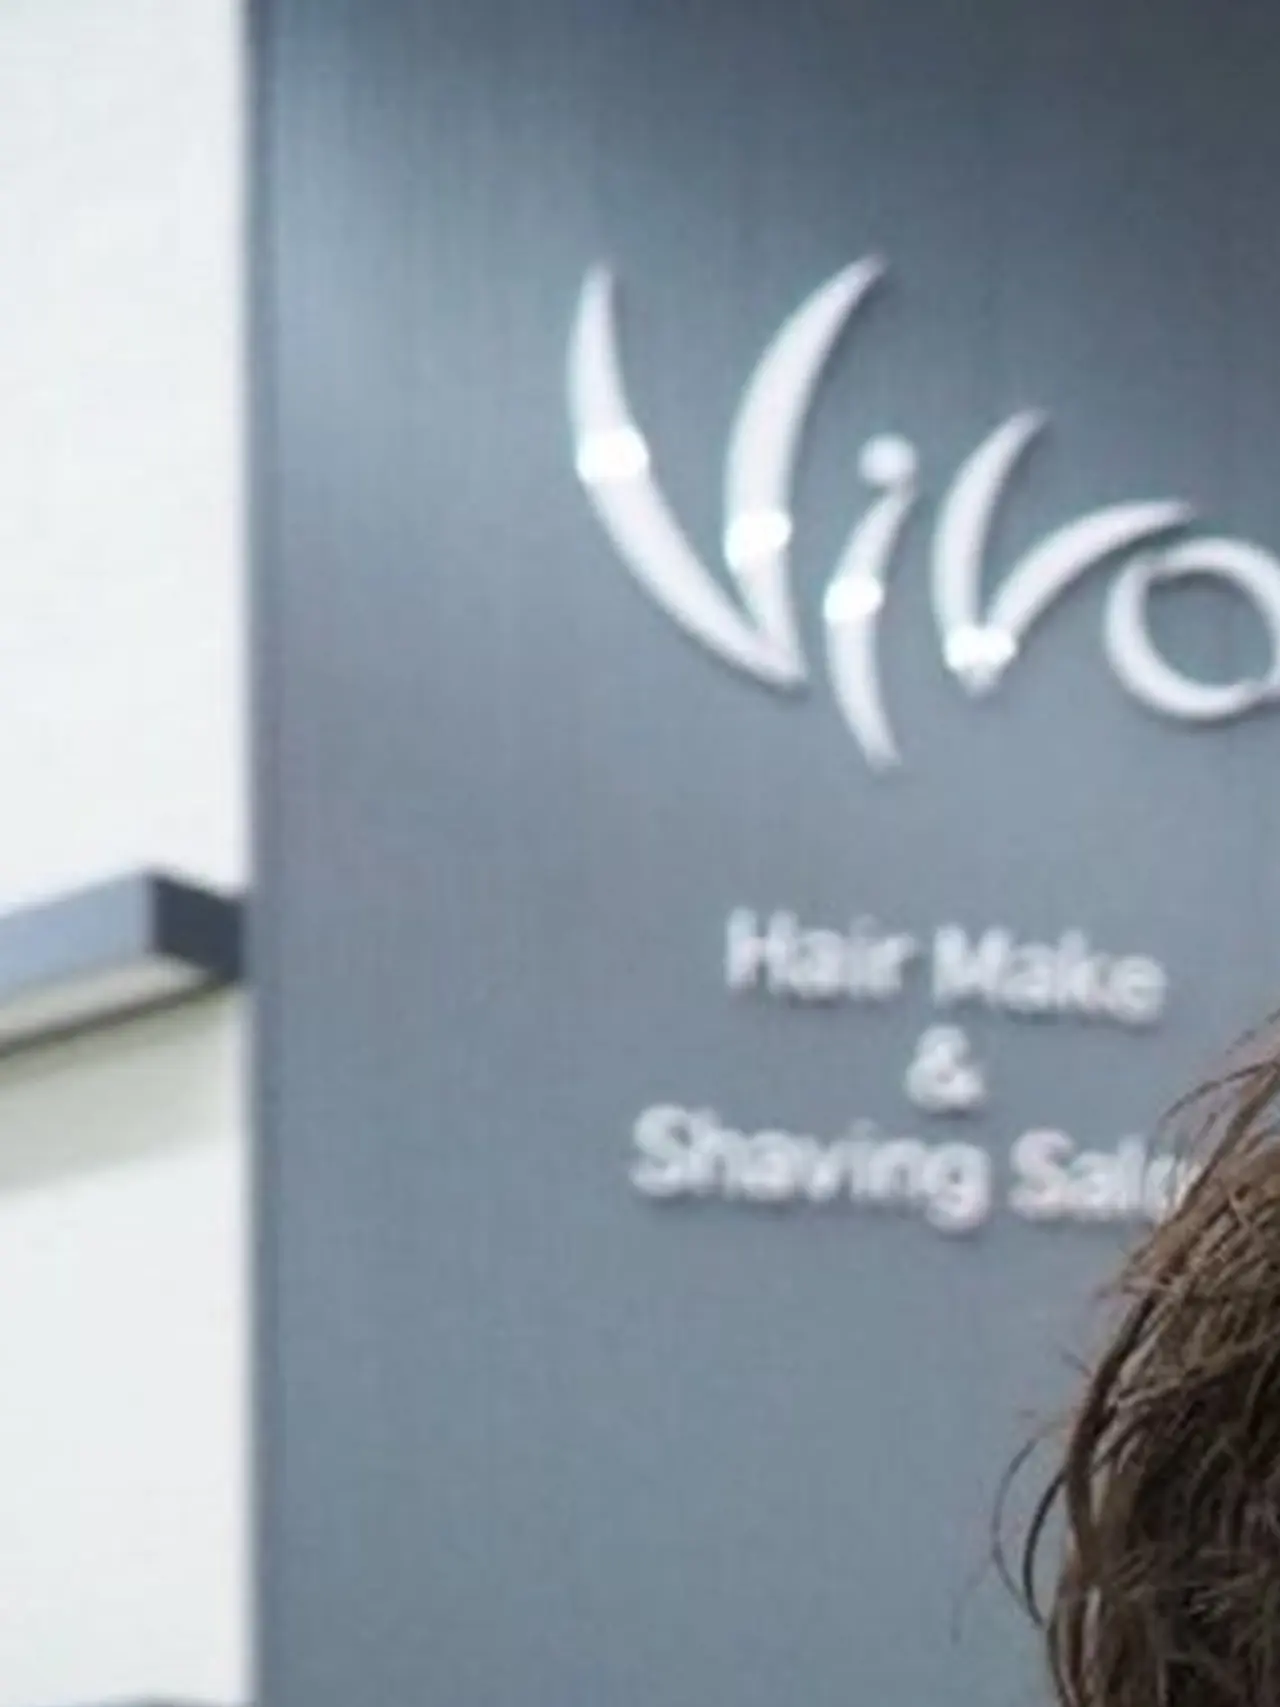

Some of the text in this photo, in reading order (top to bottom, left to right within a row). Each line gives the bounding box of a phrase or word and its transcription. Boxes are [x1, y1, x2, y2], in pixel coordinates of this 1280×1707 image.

[722, 906, 1168, 1020] Hair Make
[905, 1025, 985, 1105] &
[631, 1103, 1196, 1230] Shaving Salo
